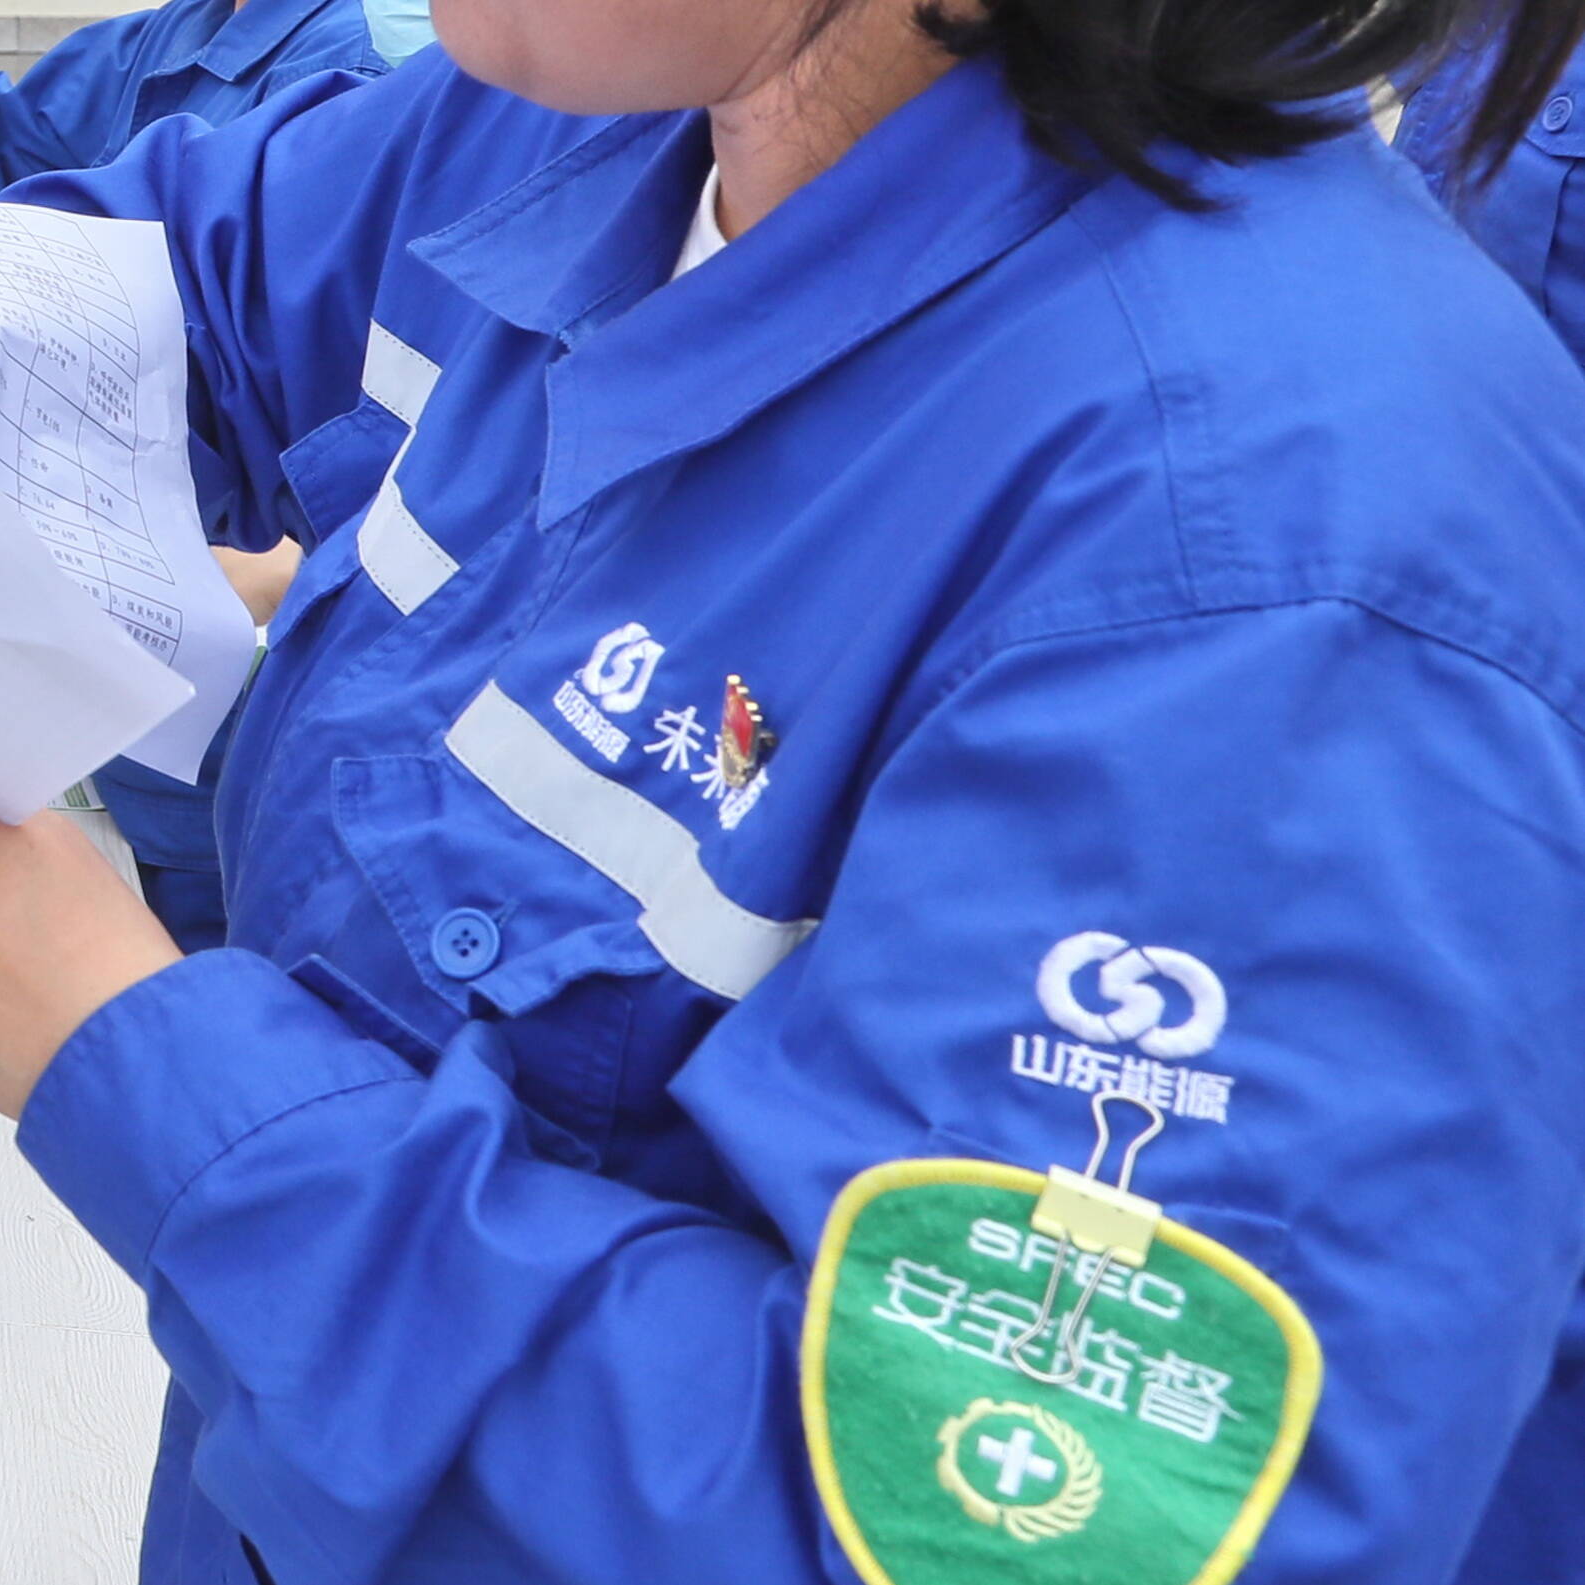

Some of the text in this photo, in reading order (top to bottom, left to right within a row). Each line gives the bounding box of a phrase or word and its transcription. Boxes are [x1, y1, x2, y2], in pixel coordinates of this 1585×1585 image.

[1010, 1032, 1236, 1126] 山东能源
[965, 1217, 1187, 1321] SFEC
[870, 1255, 1241, 1445] 安全监督
